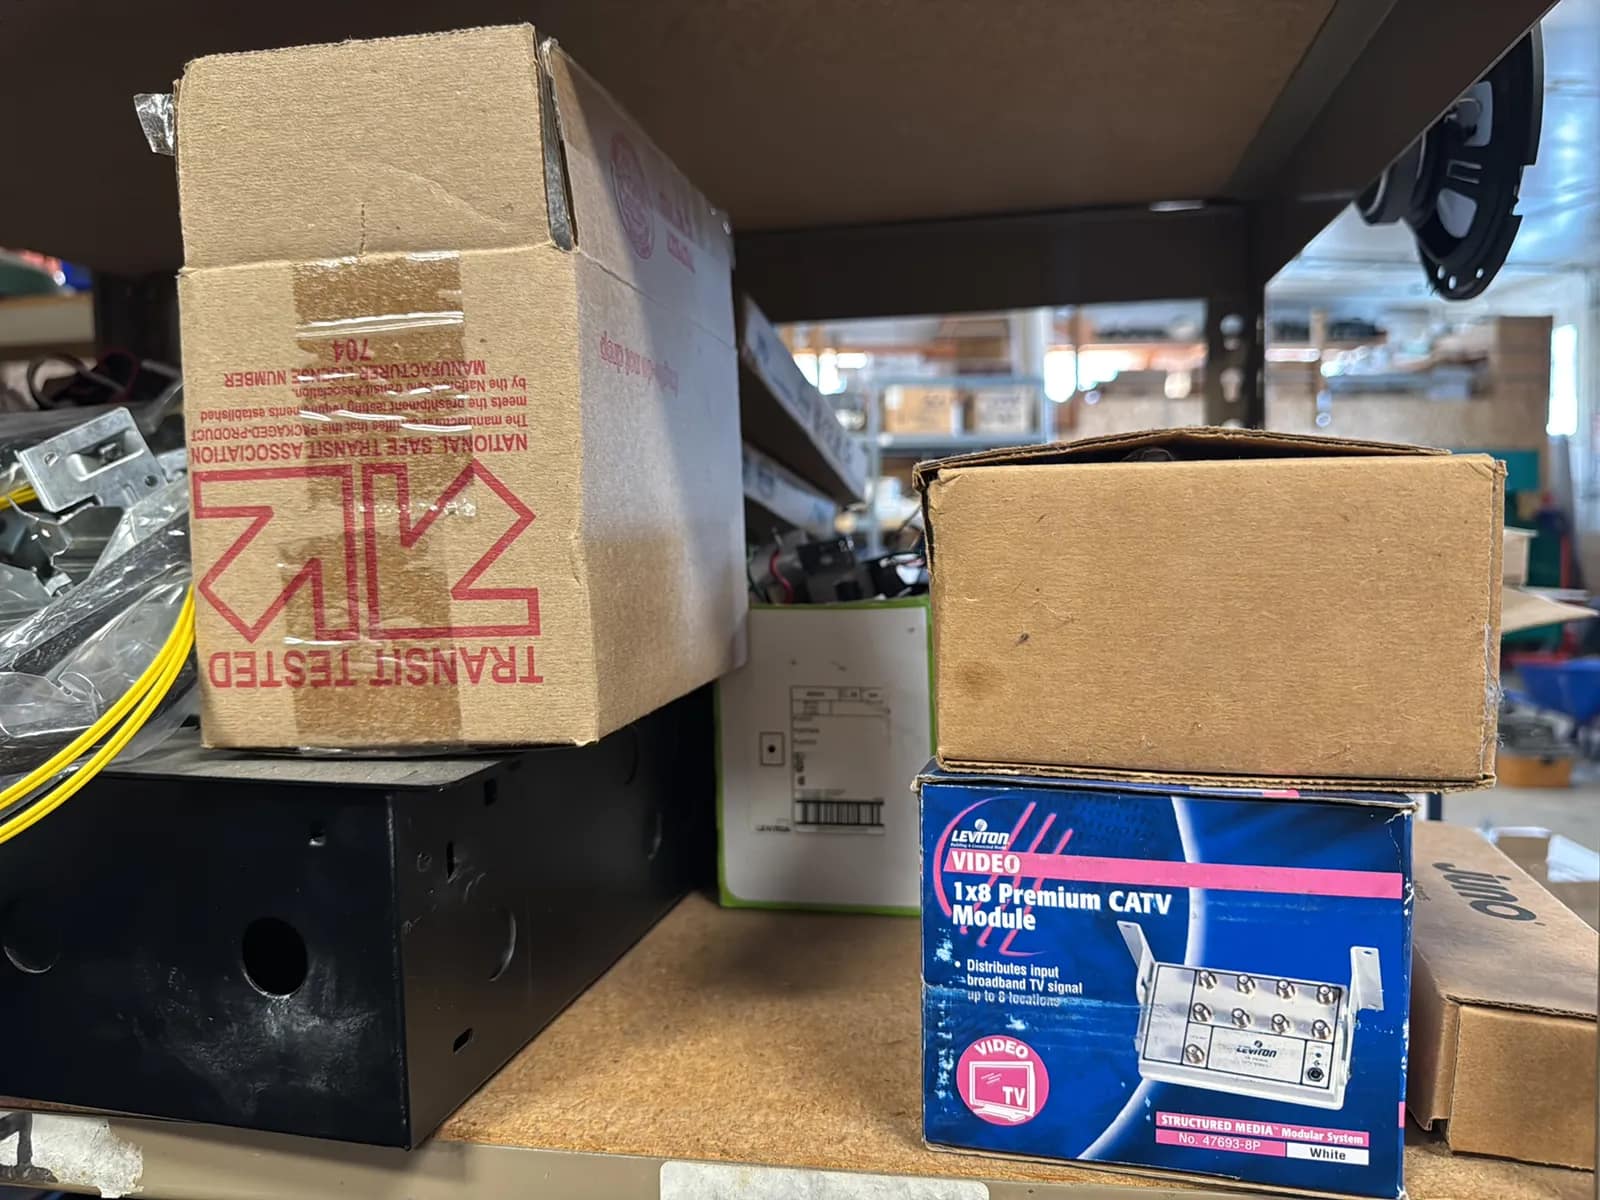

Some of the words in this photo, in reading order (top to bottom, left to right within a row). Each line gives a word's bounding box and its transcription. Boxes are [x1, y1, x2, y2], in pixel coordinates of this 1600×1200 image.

[332, 339, 372, 362] 704
[224, 370, 287, 388] NUMBER
[291, 367, 354, 386] LICENSE
[360, 360, 486, 381] MANUFACTURER
[435, 380, 485, 393] Nation
[489, 378, 508, 391] the
[511, 375, 526, 390] by
[389, 398, 465, 413] preshipment
[468, 398, 487, 410] the
[491, 396, 527, 409] meets
[200, 408, 265, 423] established
[505, 413, 528, 428] The
[191, 424, 318, 442] PACKAGED-PRODUCT
[321, 424, 343, 436] this
[307, 440, 382, 458] TRANSIT
[387, 437, 432, 456] SAFE
[438, 434, 528, 454] NATIONAL
[191, 443, 303, 465] ASSOCIATION
[209, 648, 357, 688] TESTED
[369, 646, 544, 686] TRANSIT
[951, 851, 1020, 874] VIDEO
[954, 881, 991, 902] 1x8
[999, 883, 1100, 911] Premium
[1109, 890, 1172, 915] CATV
[953, 904, 1036, 930] Module
[967, 959, 1027, 975] Distributes
[1030, 964, 1059, 979] input
[967, 974, 1026, 990] broadband
[1029, 979, 1044, 992] TV
[1047, 982, 1083, 995] signal
[967, 991, 981, 1004] up
[984, 990, 995, 1002] to
[1009, 992, 1060, 1007] locations
[974, 1039, 1028, 1058] VIDEO
[1002, 1086, 1025, 1106] TV
[1161, 1114, 1232, 1131] STRUCTURED
[1281, 1128, 1324, 1142] Modular
[1327, 1132, 1363, 1146] System
[1178, 1132, 1198, 1145] No.
[1203, 1134, 1260, 1151] 47693-8P
[1309, 1147, 1346, 1161] White
